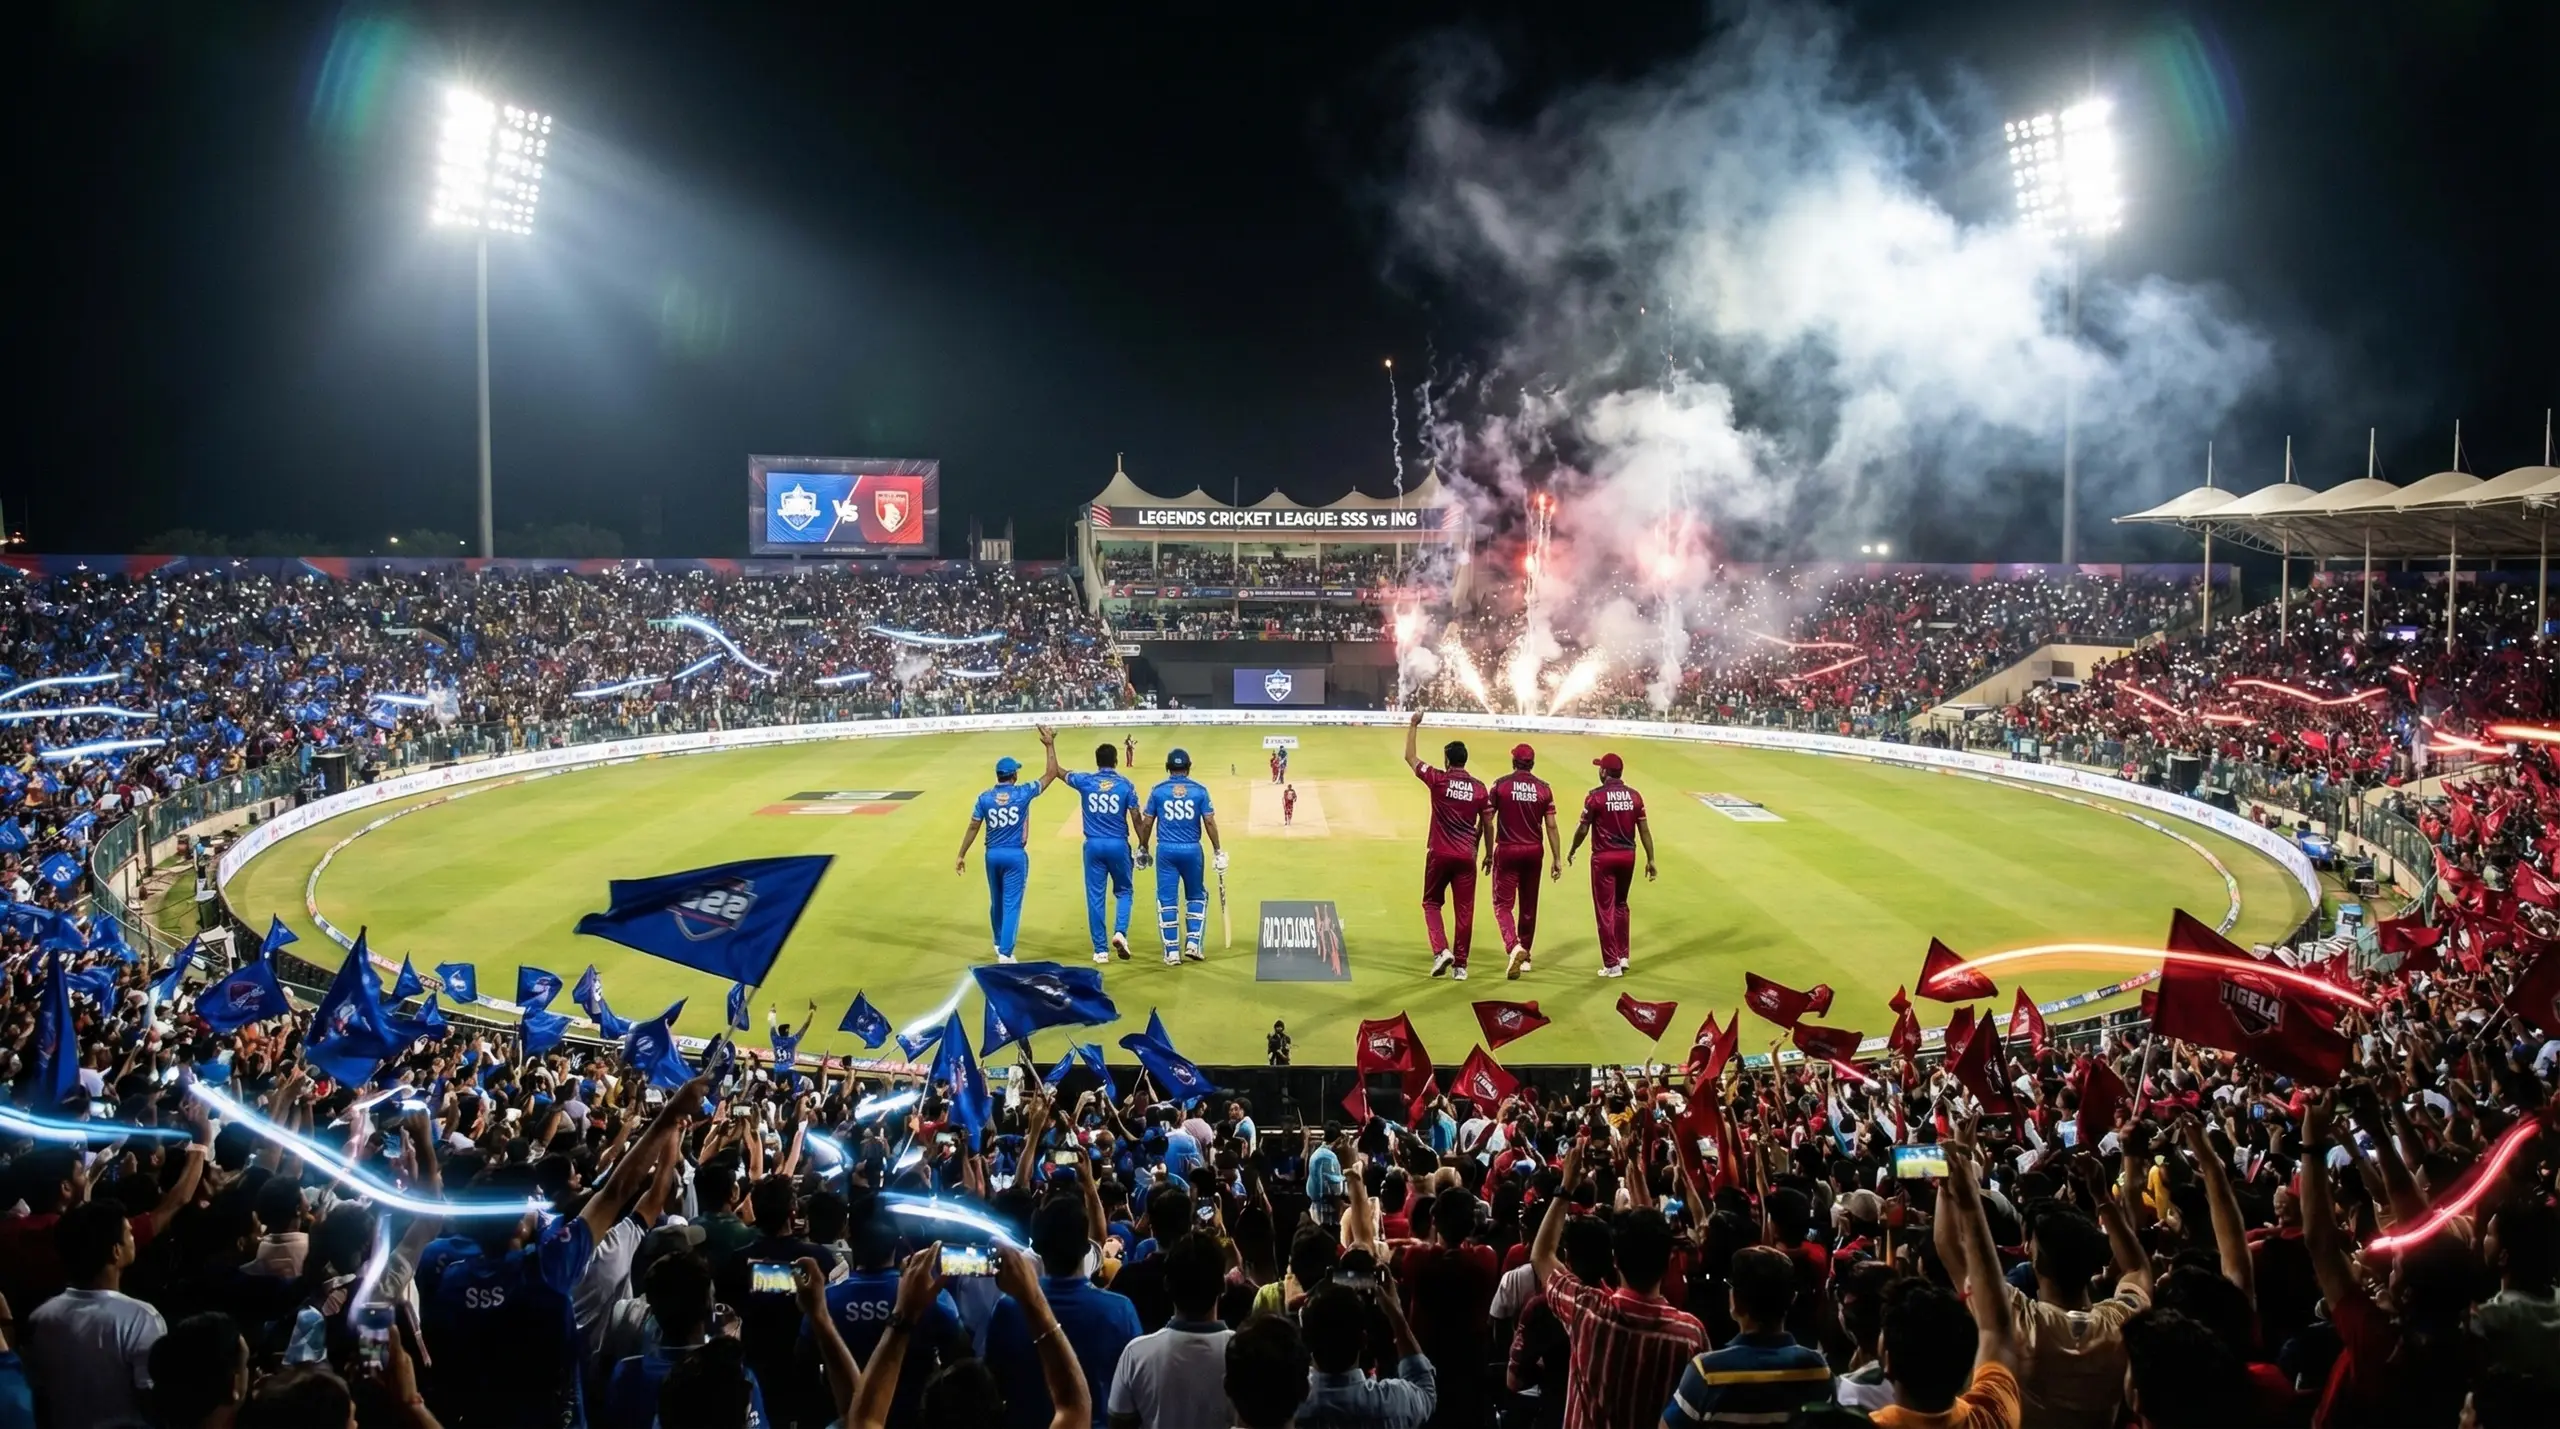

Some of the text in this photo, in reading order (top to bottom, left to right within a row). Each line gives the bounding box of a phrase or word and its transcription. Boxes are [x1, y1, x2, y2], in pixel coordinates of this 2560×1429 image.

[1138, 510, 1417, 526] LEGENDS CRICKET LEAGUE: SSS vs ING
[1088, 793, 1120, 815] SSS
[1163, 799, 1195, 821] SSS
[988, 806, 1019, 829] SSS
[2222, 982, 2280, 1024] TIGELA
[465, 1286, 505, 1309] SSS
[845, 1300, 890, 1322] SSS
